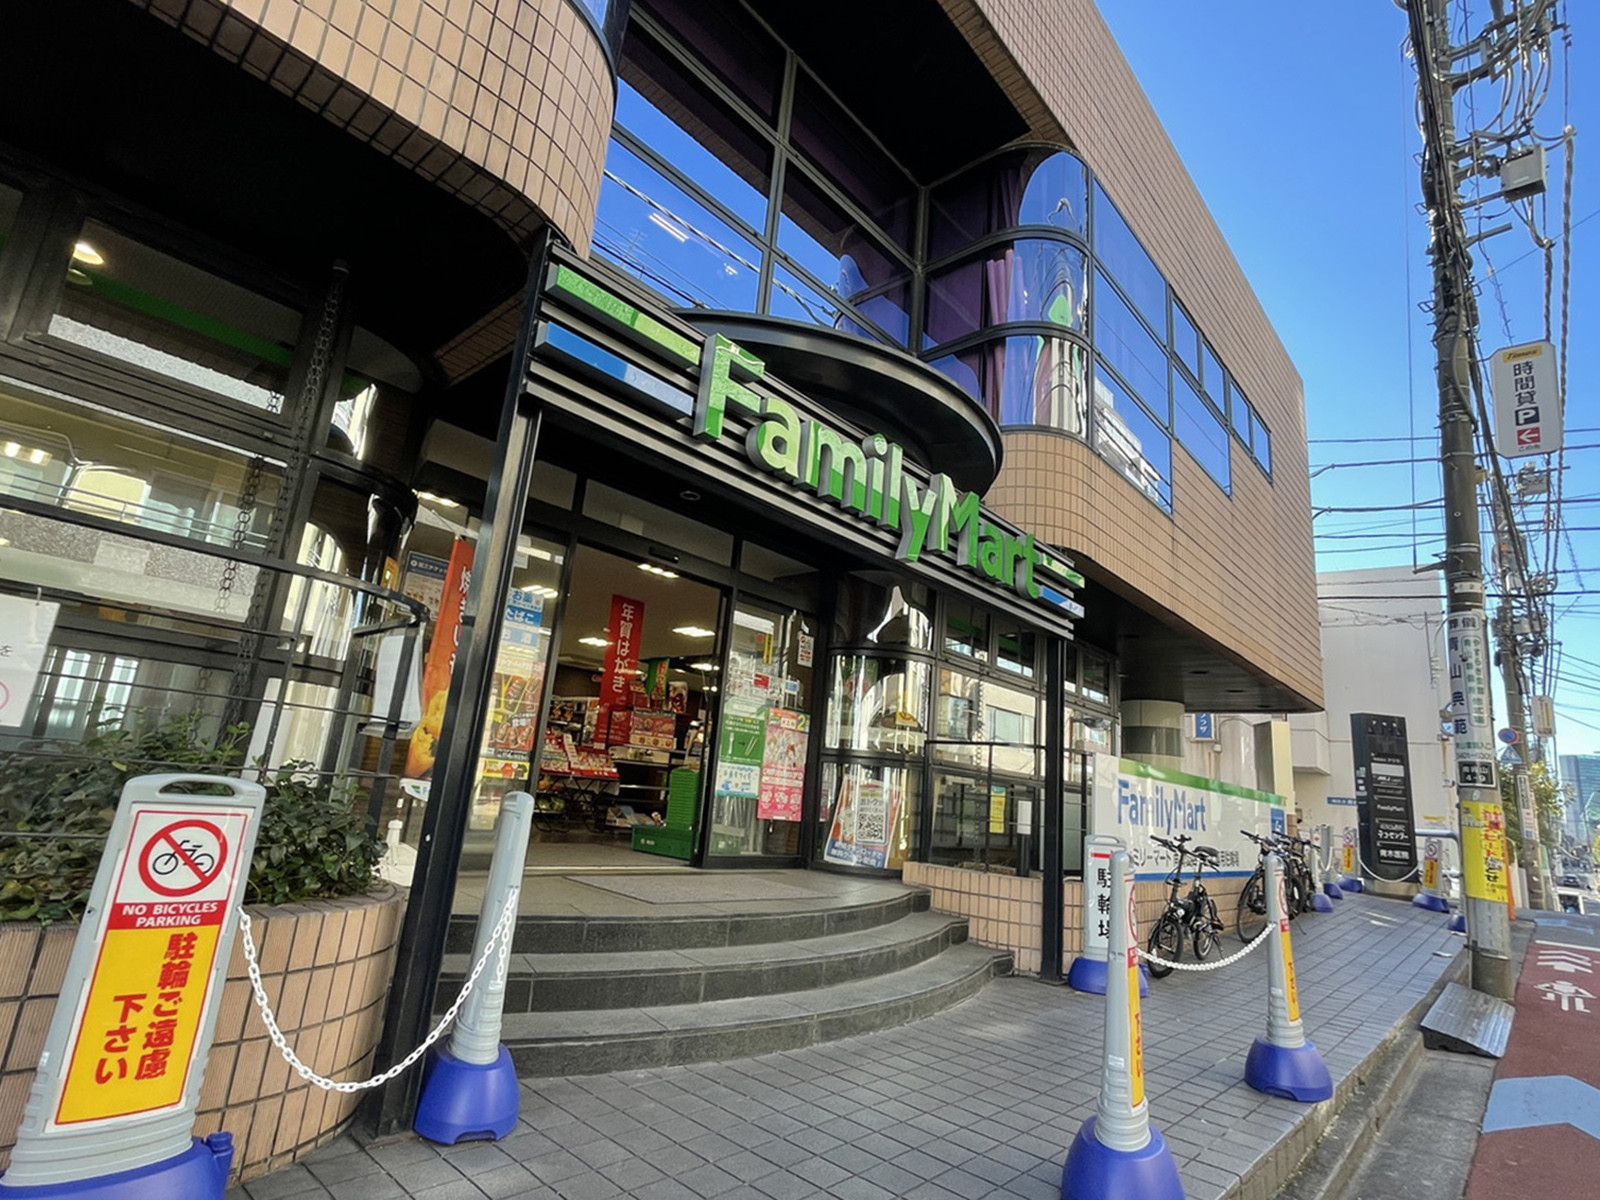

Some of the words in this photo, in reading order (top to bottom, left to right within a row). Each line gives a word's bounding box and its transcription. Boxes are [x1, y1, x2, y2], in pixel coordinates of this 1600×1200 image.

[1513, 360, 1537, 408] 時間貸
[1517, 407, 1540, 426] P
[693, 332, 1040, 599] FamilyMart
[612, 602, 635, 693] 年賀はがき
[1117, 779, 1206, 836] FamilyMart
[122, 905, 147, 916] NO
[152, 902, 218, 915] BICYCLES
[135, 915, 202, 927] PARKING
[134, 931, 198, 1081] 駐輪ご遠慮
[94, 993, 148, 1085] 下さい
